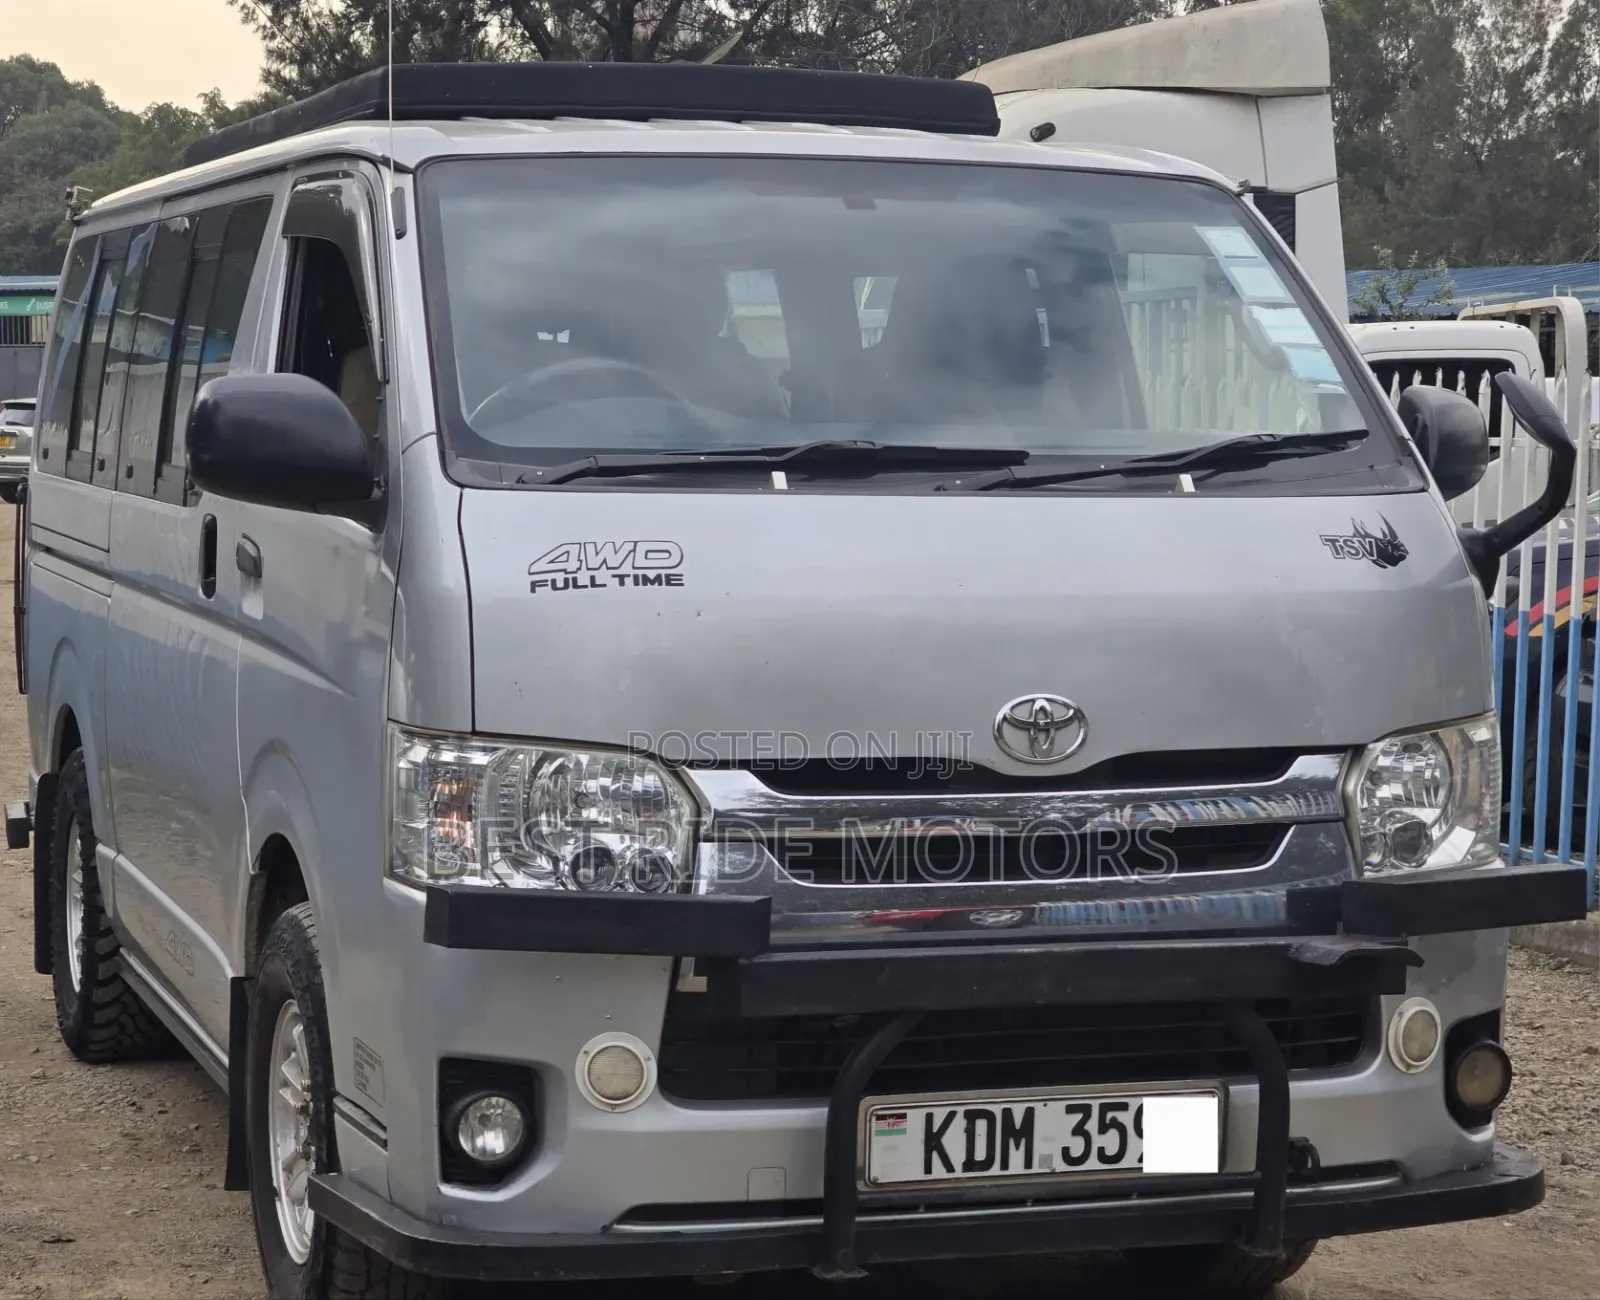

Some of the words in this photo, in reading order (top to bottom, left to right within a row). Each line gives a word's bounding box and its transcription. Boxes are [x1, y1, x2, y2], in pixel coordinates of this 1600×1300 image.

[528, 540, 684, 575] 4WD
[1319, 534, 1378, 560] TSV
[530, 575, 607, 594] FULL
[611, 573, 685, 587] TIME
[923, 1106, 1035, 1175] KDM
